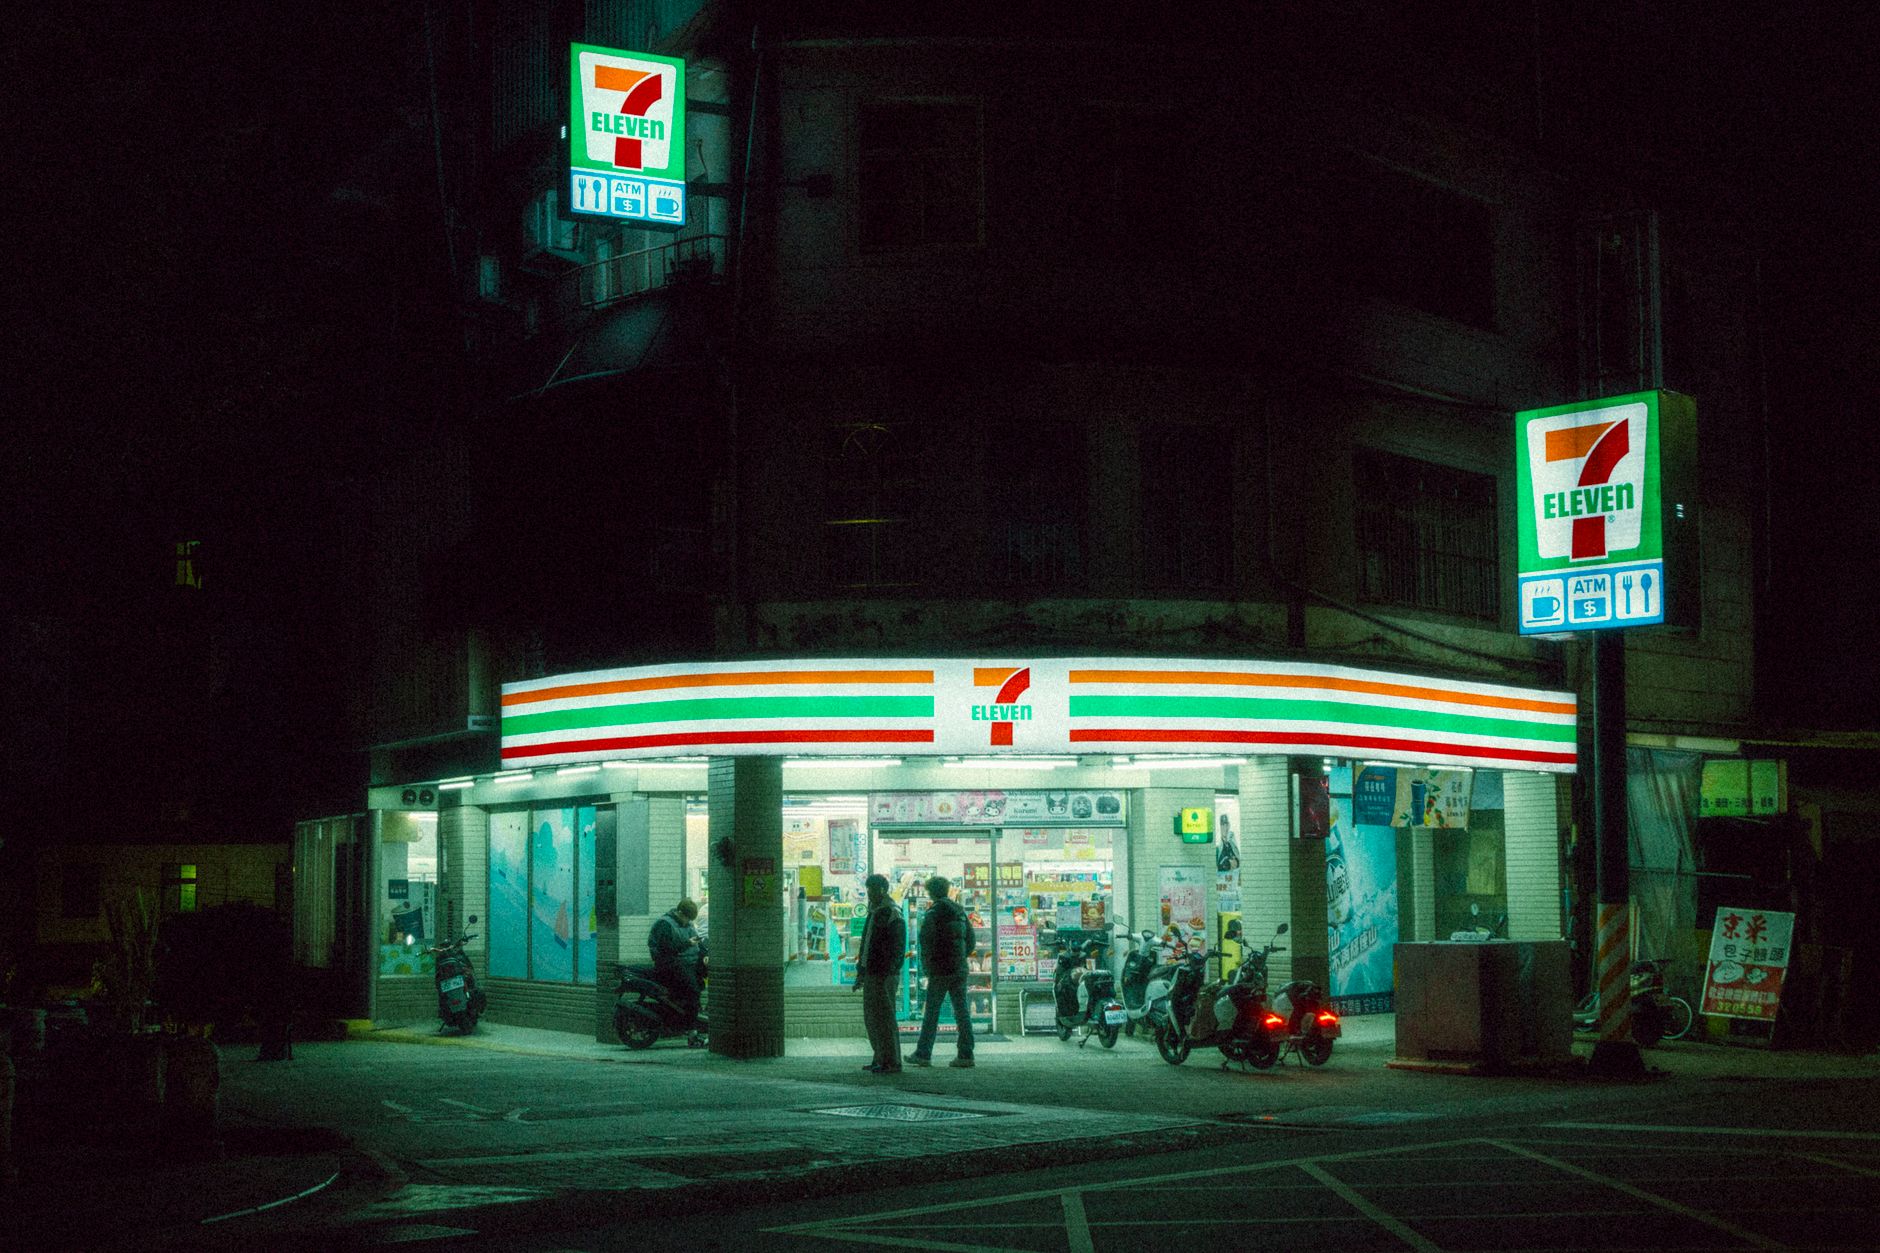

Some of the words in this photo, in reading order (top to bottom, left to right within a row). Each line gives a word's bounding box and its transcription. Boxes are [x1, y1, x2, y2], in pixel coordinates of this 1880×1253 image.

[595, 65, 662, 170] 7
[615, 183, 641, 195] ATM
[1545, 418, 1630, 560] 7
[1573, 578, 1606, 594] ATM
[973, 667, 1030, 746] 7
[1013, 945, 1031, 957] 120
